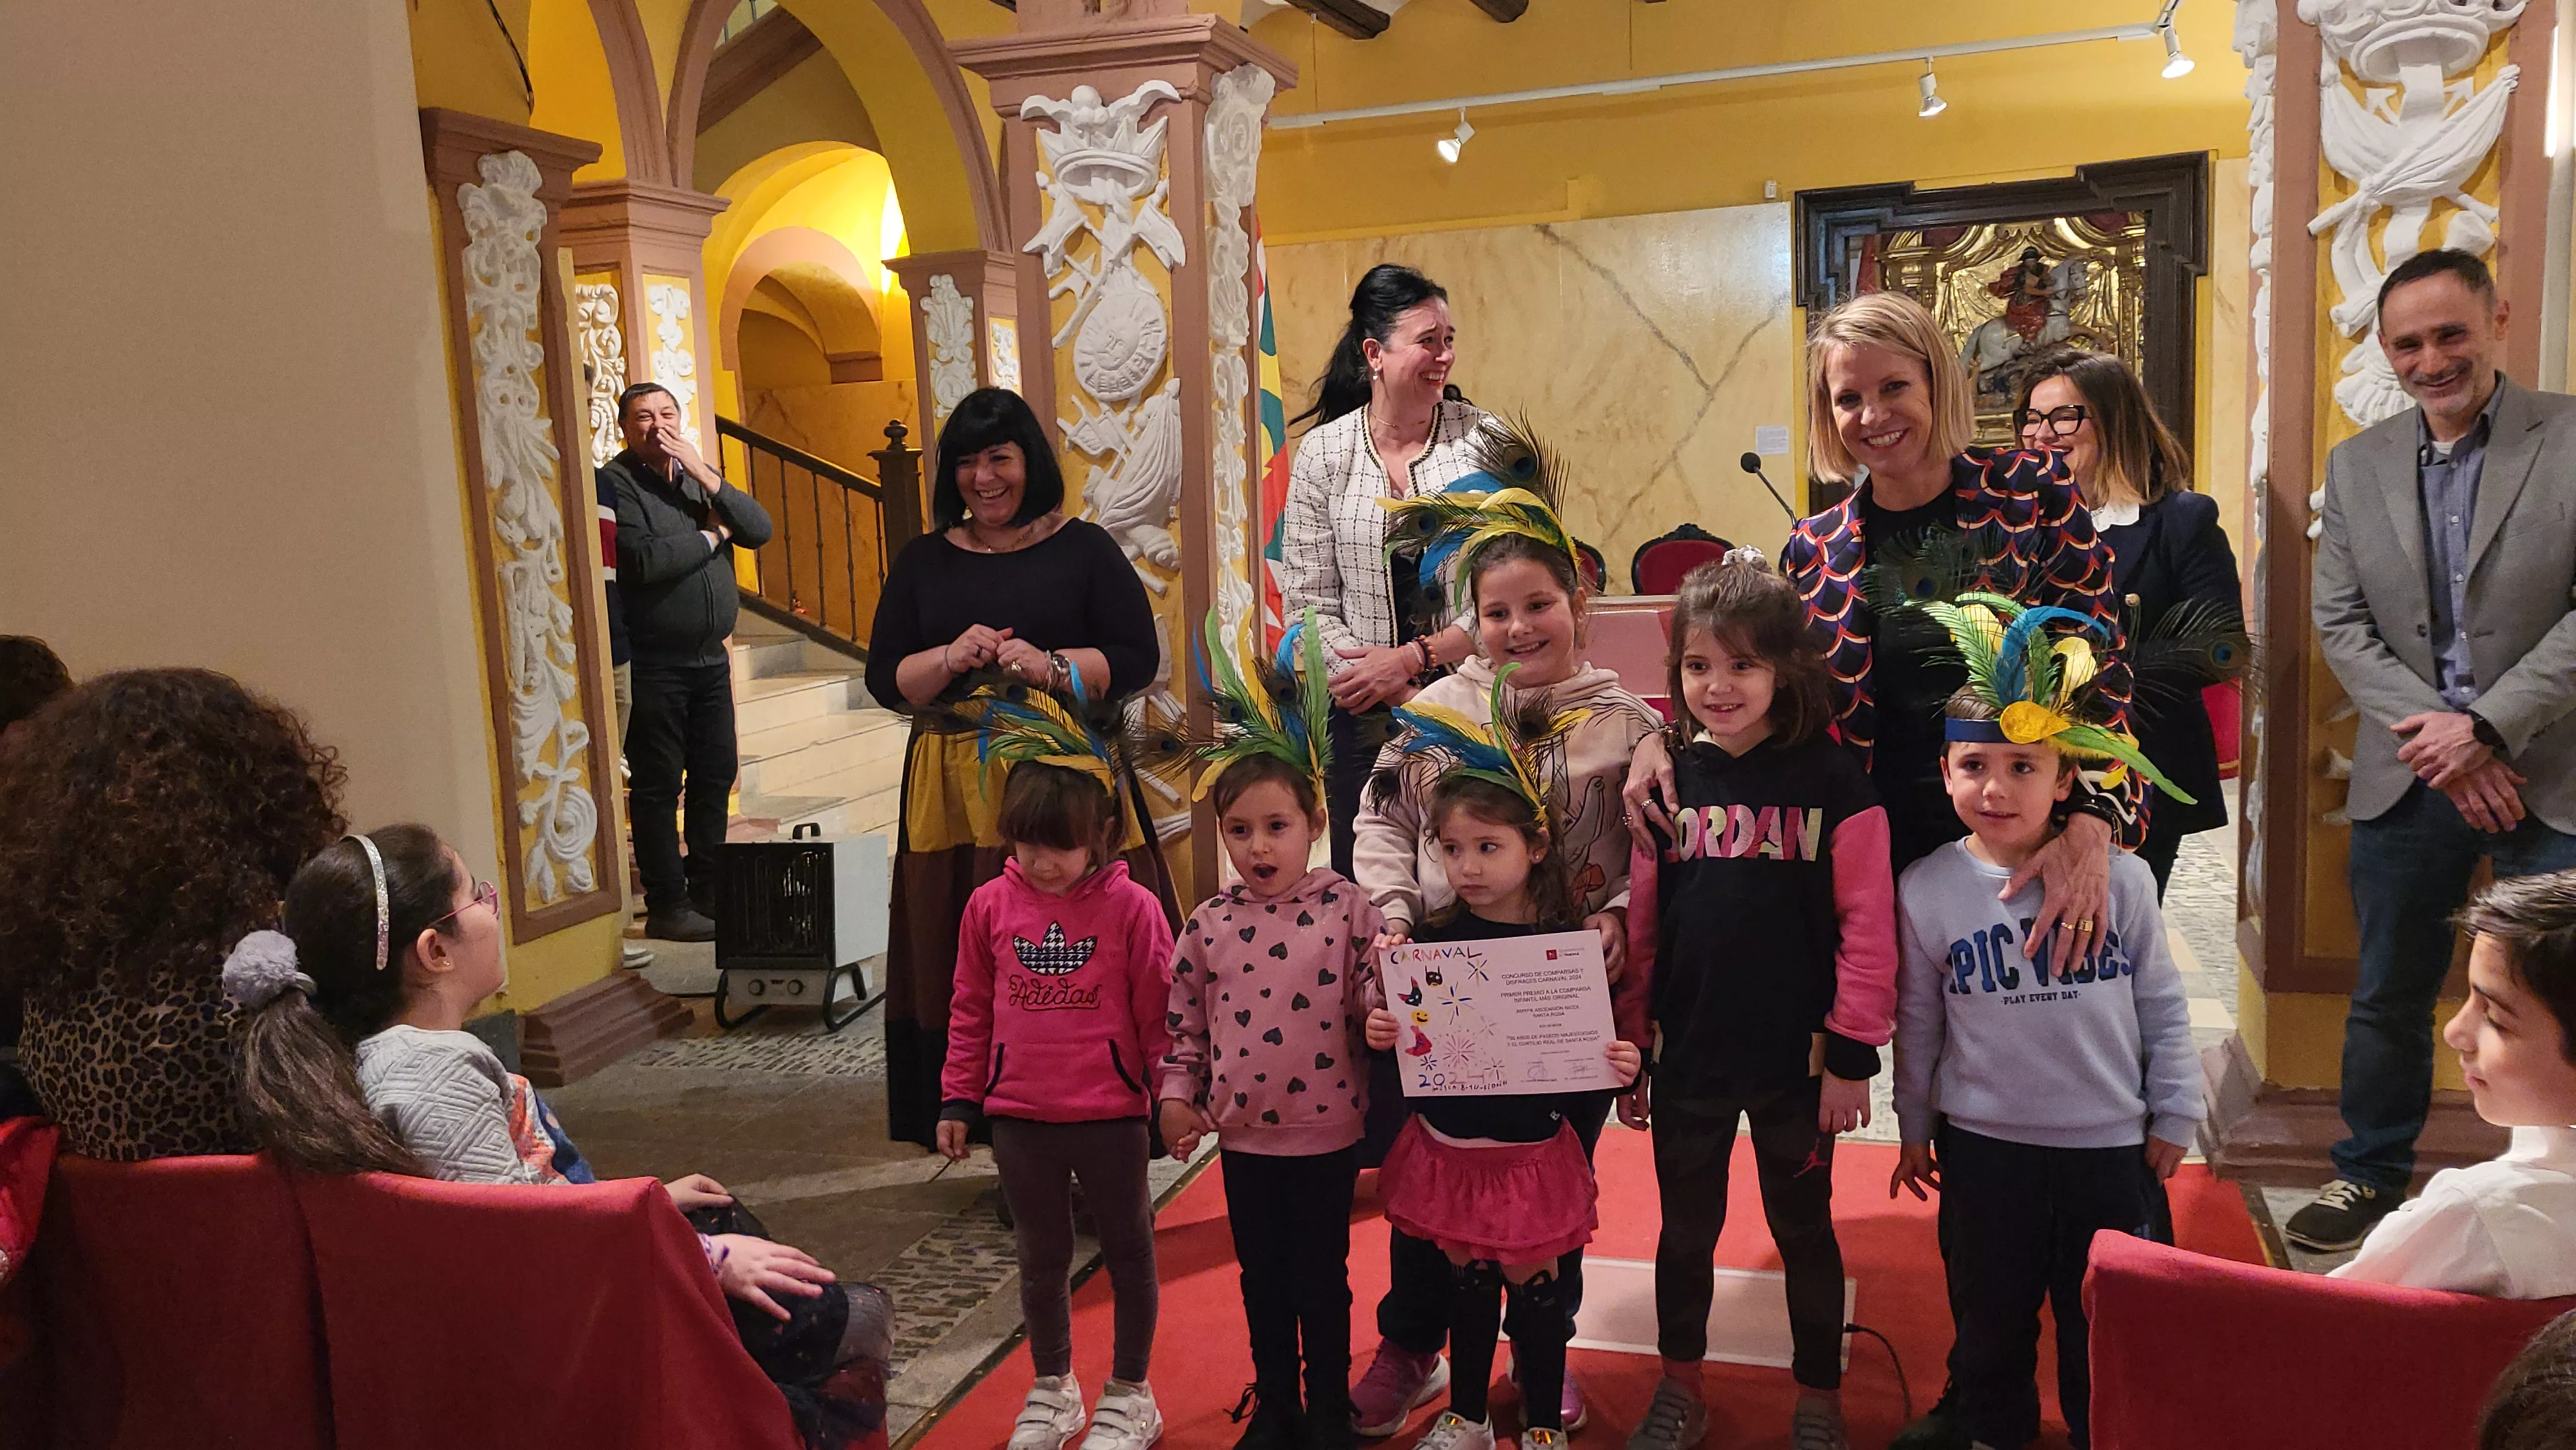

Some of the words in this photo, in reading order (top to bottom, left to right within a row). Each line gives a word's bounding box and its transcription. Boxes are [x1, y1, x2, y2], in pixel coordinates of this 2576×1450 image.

[1664, 804, 1823, 863] ORDAN
[1390, 945, 1483, 965] CARNAVAL
[1946, 923, 2020, 994] PIC
[1543, 968, 1579, 977] COMPARSAS
[1008, 974, 1103, 1012] Adidas
[2029, 992, 2058, 1003] EVERY
[1418, 1070, 1484, 1088] 2024
